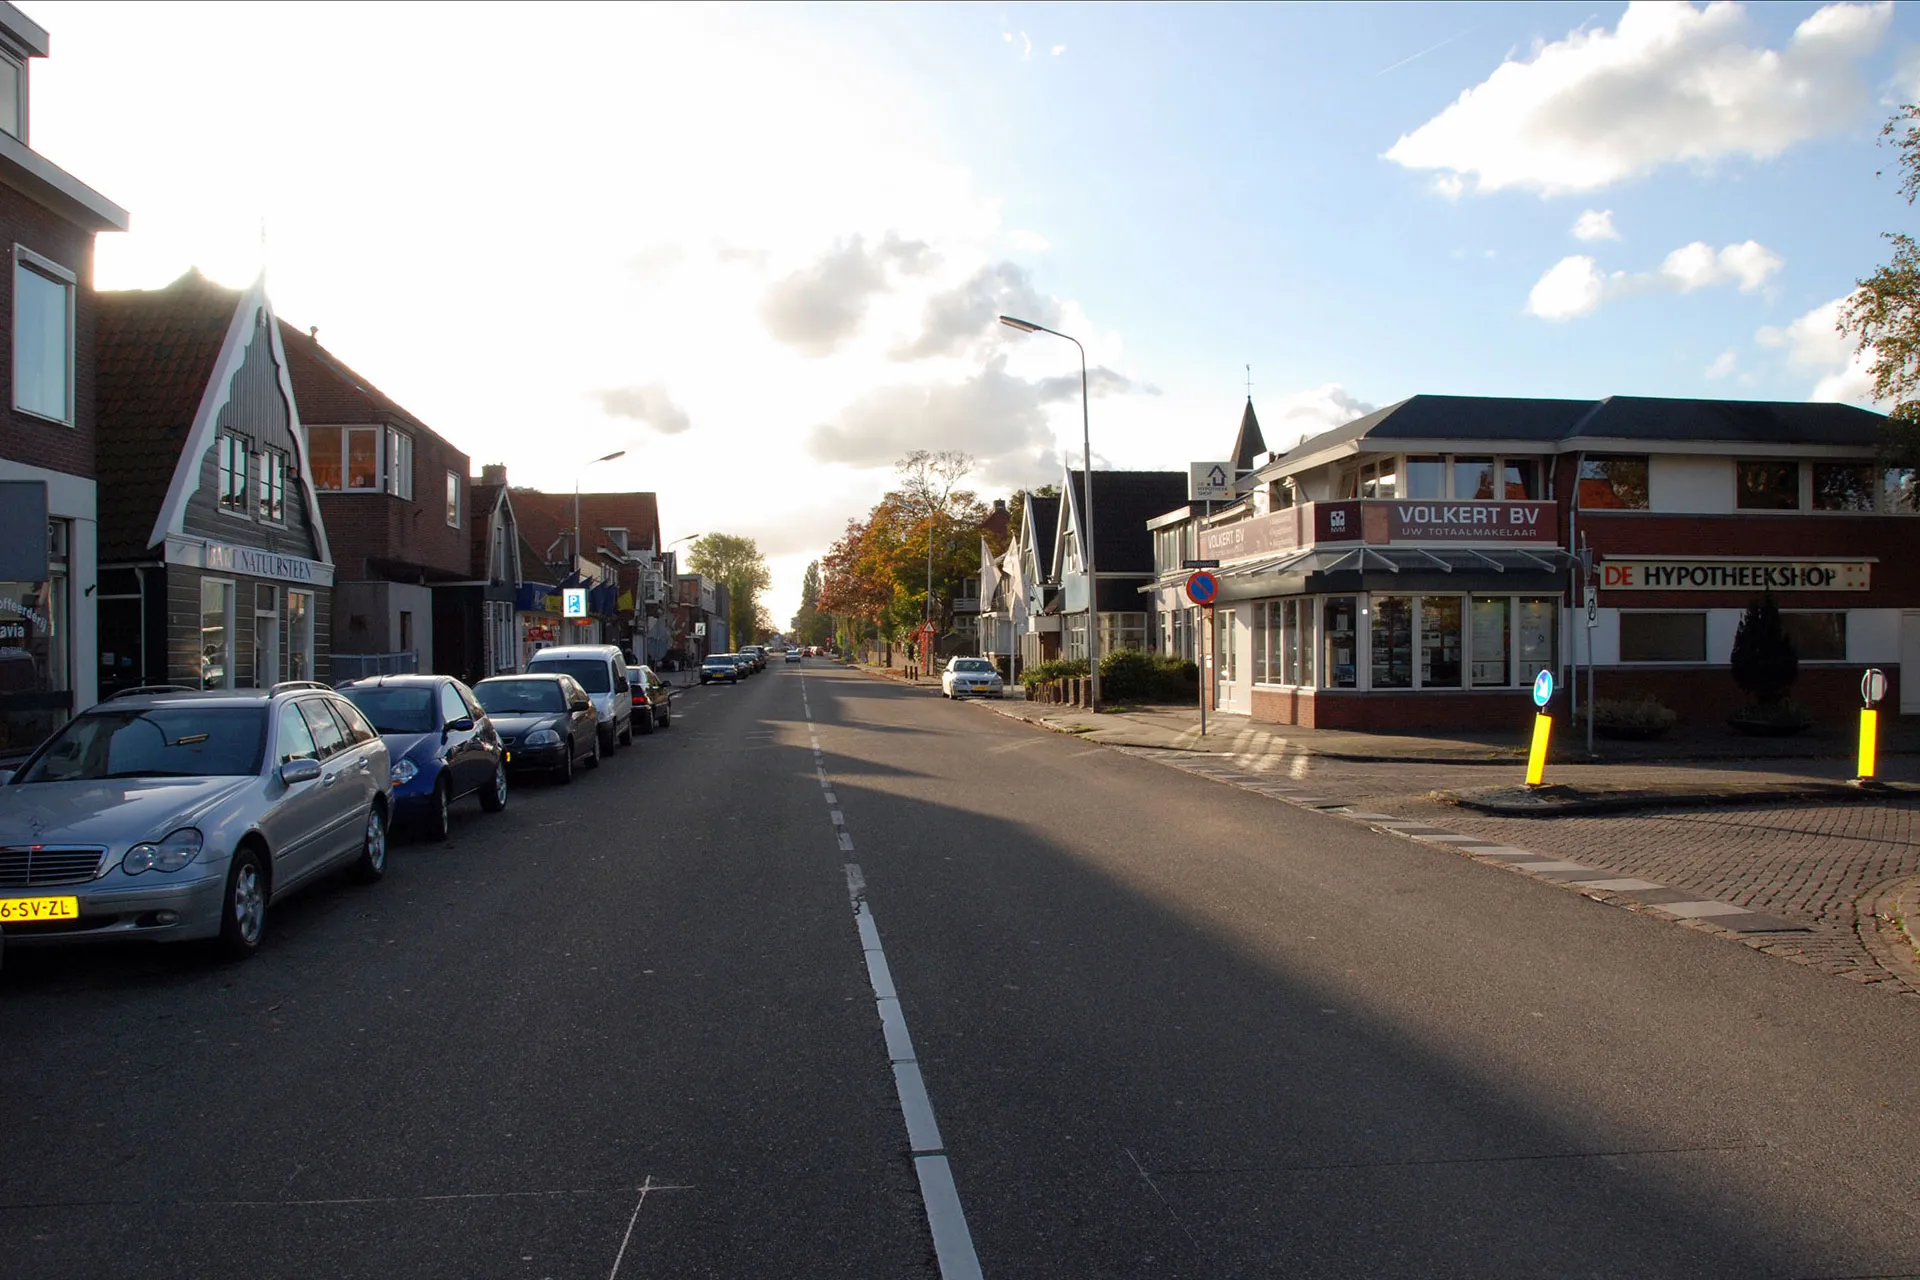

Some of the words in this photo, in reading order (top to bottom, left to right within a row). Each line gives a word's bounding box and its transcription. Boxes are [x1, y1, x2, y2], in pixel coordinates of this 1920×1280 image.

[1398, 506, 1501, 524] VOLKERT
[1509, 507, 1540, 524] BV
[1207, 530, 1234, 549] VOLKERT
[1235, 527, 1245, 543] BV
[1402, 528, 1422, 536] UW
[1428, 528, 1537, 537] TOTAALMAKELAAR
[241, 550, 312, 580] NATUURSTEEN
[1604, 566, 1634, 586] DE
[1644, 566, 1837, 587] HYPOTHEEKSHOP
[0, 622, 25, 638] avia
[1, 900, 71, 918] 6-SV-ZL
